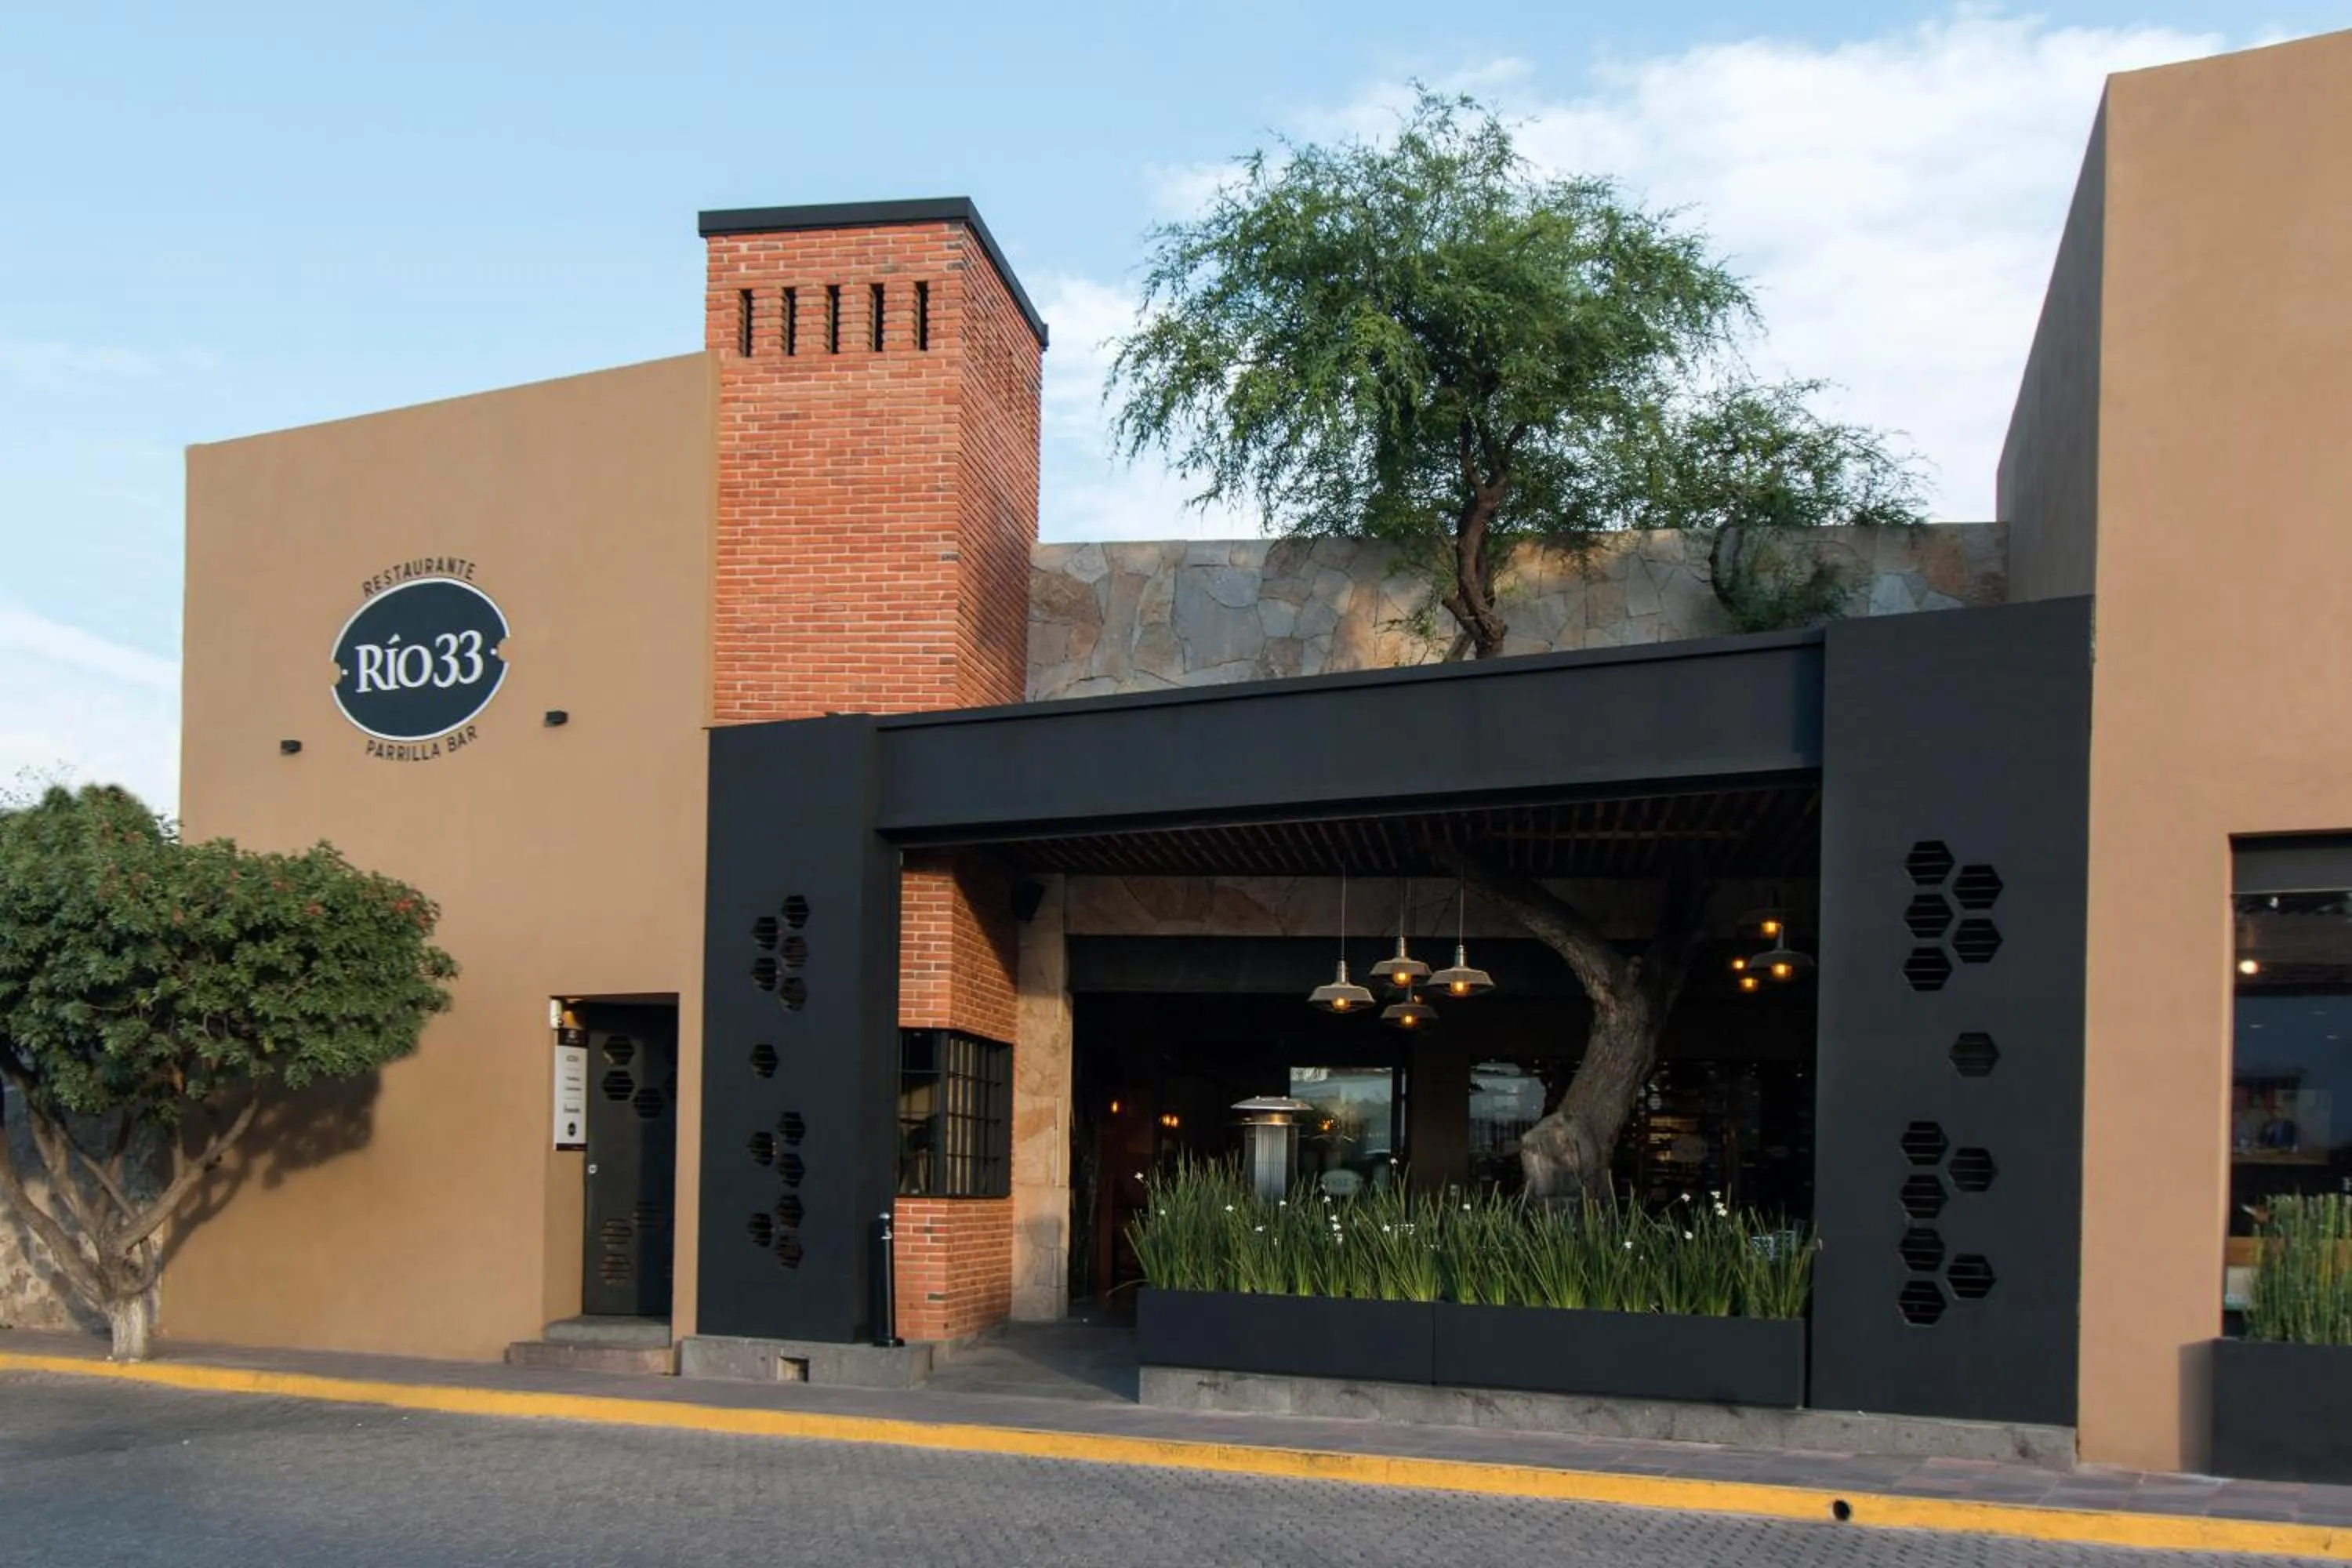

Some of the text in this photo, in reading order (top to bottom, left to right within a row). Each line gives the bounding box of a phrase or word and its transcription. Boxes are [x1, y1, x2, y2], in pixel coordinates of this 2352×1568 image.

[362, 557, 476, 597] RESTAURANTE
[365, 725, 477, 762] PARRILLA BAR
